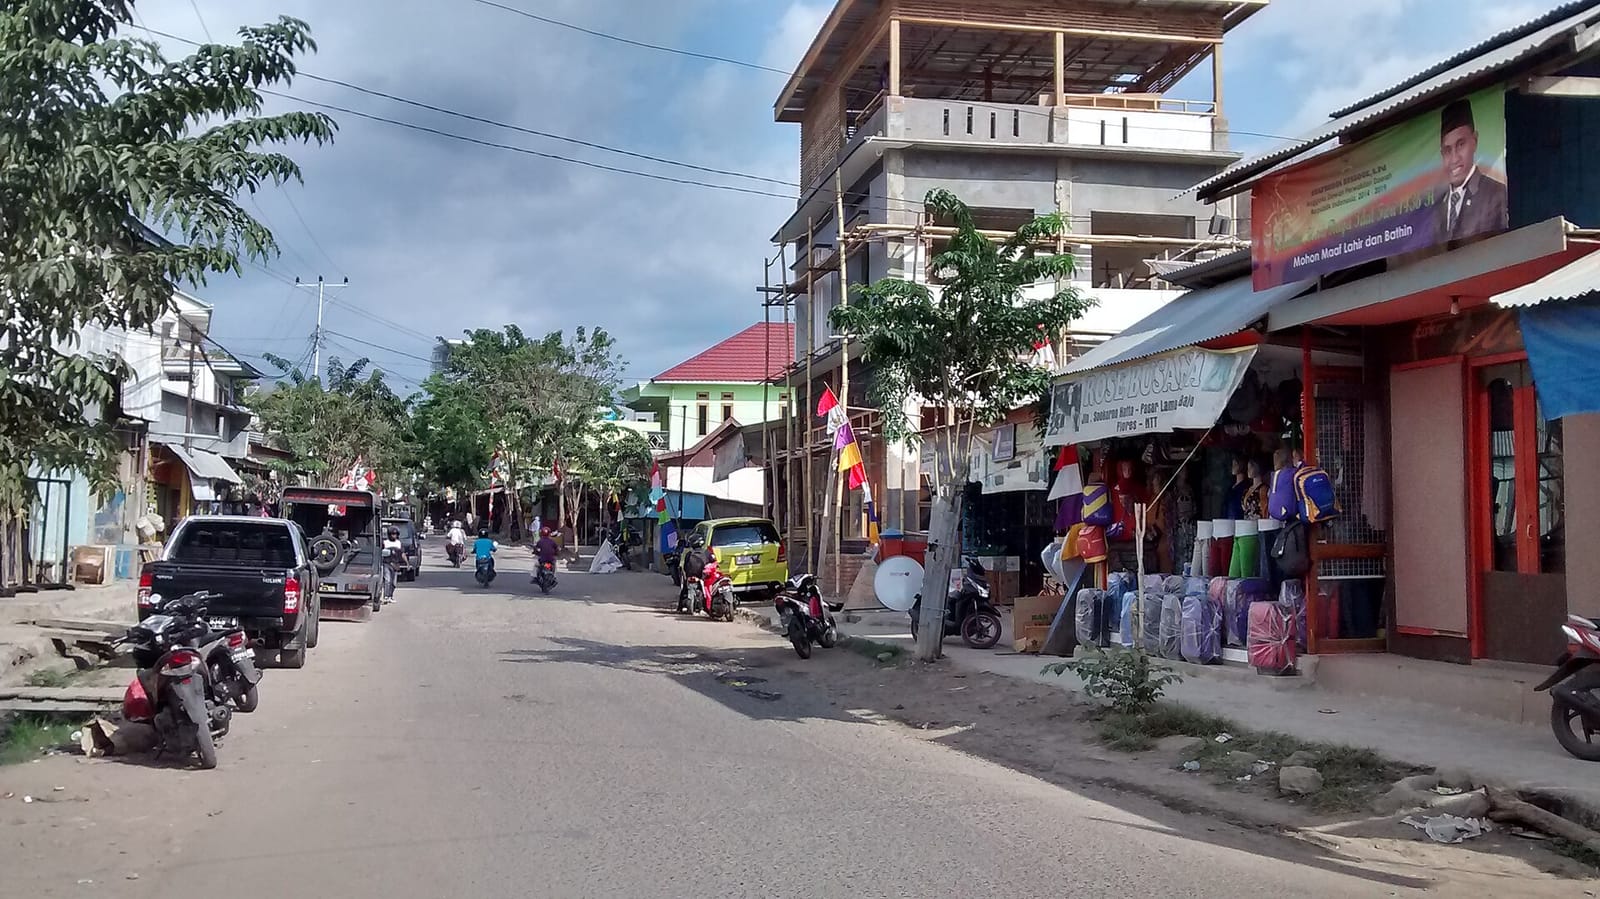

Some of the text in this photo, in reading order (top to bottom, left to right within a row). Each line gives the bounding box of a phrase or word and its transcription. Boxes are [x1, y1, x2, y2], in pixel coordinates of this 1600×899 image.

[1293, 223, 1413, 268] Mohon Maaf Lahir dan Bathin
[1119, 405, 1134, 418] Hatta
[1140, 401, 1160, 415] Pasar
[1116, 420, 1138, 433] Flores
[1145, 415, 1159, 429] NTT
